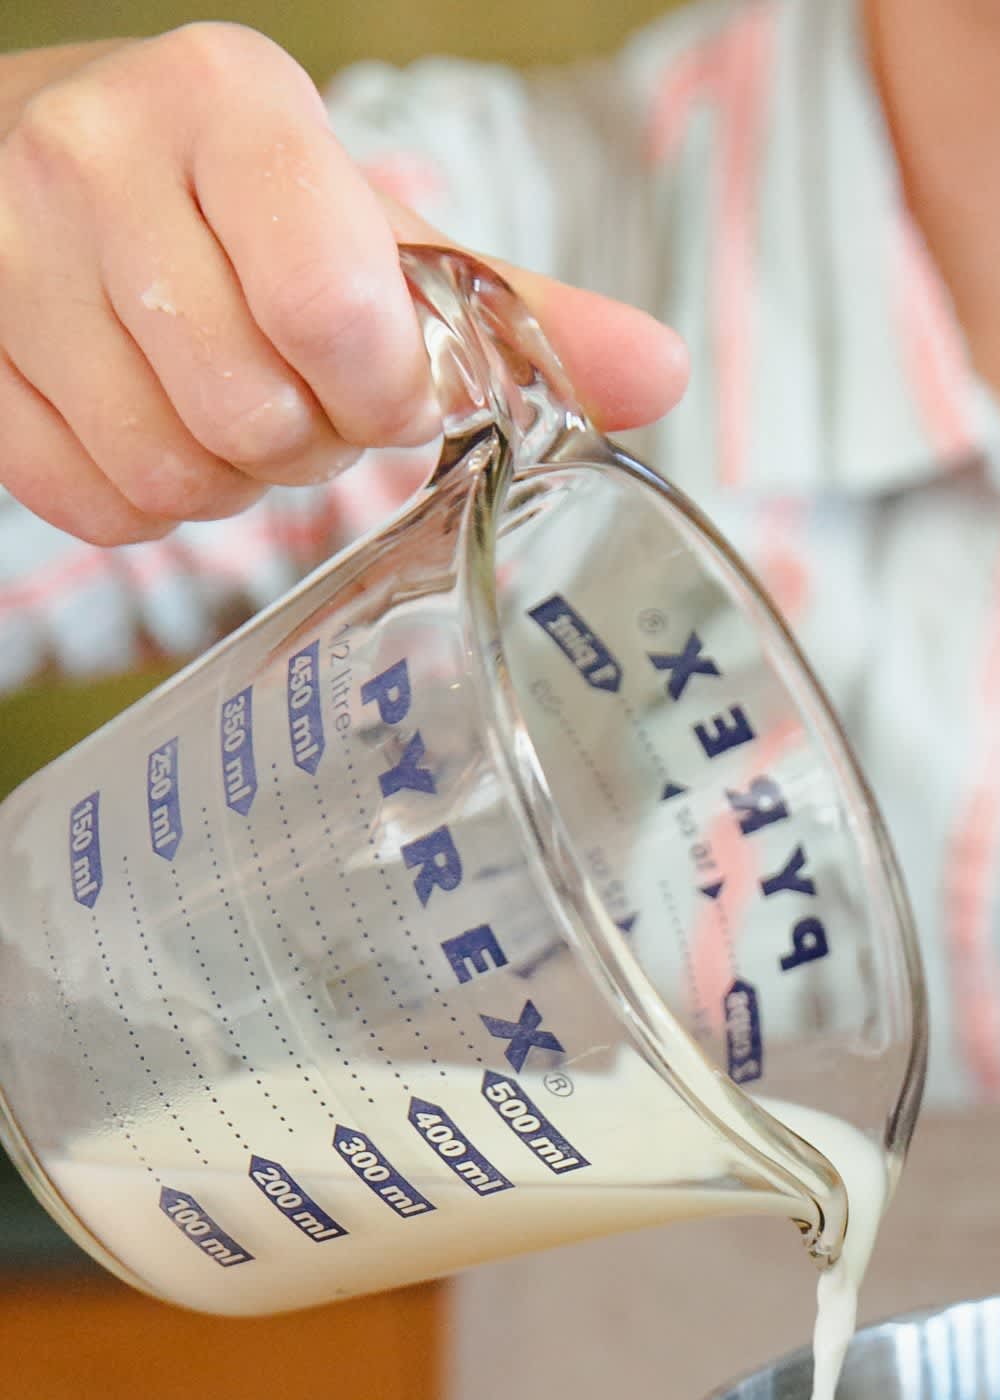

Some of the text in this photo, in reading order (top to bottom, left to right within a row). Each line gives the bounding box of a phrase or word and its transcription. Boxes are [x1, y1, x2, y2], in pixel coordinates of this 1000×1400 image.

[290, 656, 320, 762] 450 ml
[330, 668, 353, 732] litre
[223, 695, 251, 803] 350 ml
[151, 747, 177, 848] 250 ml
[72, 801, 98, 898] 150 ml
[361, 658, 565, 1073] PYREX
[415, 1112, 504, 1192] 400 ml
[485, 1080, 579, 1169] 500 ml
[252, 1167, 339, 1239] 200 ml
[338, 1136, 428, 1214] 300 ml
[167, 1199, 246, 1265] 100 ml
